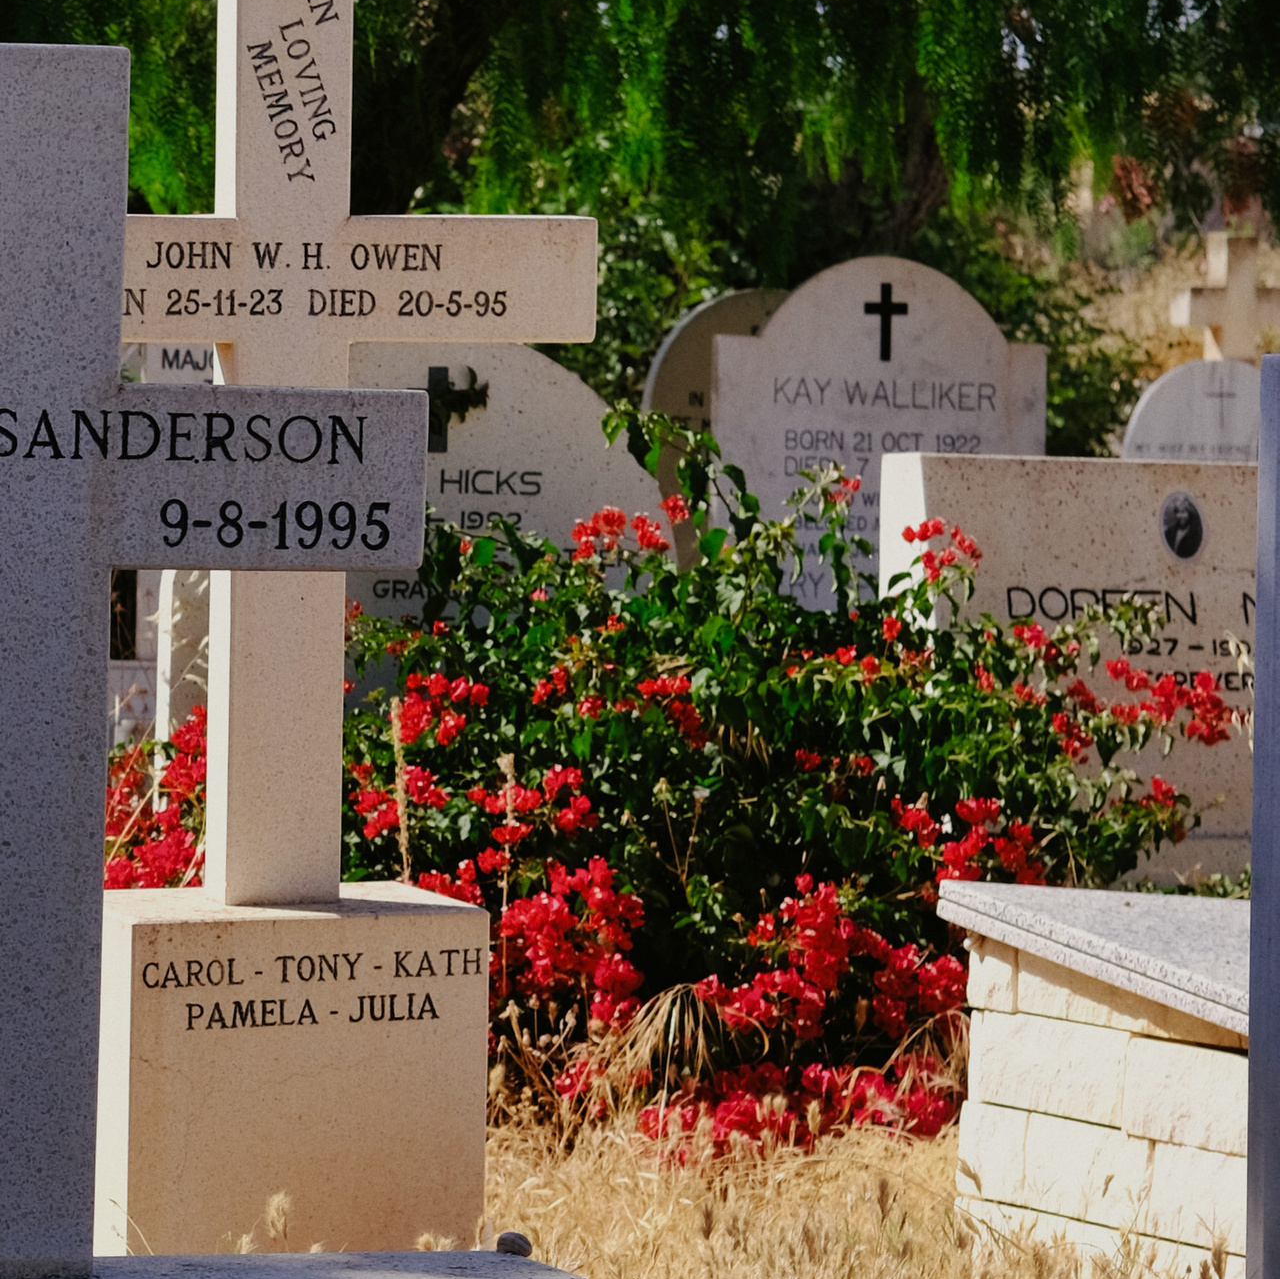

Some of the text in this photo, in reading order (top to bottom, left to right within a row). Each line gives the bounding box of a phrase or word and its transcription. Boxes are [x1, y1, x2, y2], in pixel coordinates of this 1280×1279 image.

[279, 18, 336, 142] LOVING
[247, 40, 315, 182] MEMORY
[146, 241, 233, 270] JOHN
[350, 244, 443, 272] OWEN
[165, 288, 284, 317] 25-11-23
[308, 289, 376, 317] DIED
[398, 290, 508, 318] 20-5-95
[161, 348, 214, 372] MAJ
[773, 377, 997, 411] KAY WALLIKER
[784, 429, 982, 454] BORN 21 OCT 1922
[439, 468, 542, 496] HICKS
[159, 497, 392, 552] 9-8-1995
[142, 959, 244, 989] CAROL
[275, 952, 363, 984] TONY
[393, 947, 483, 978] KATH
[185, 998, 319, 1030] PAMELA
[348, 992, 440, 1023] JULIA
